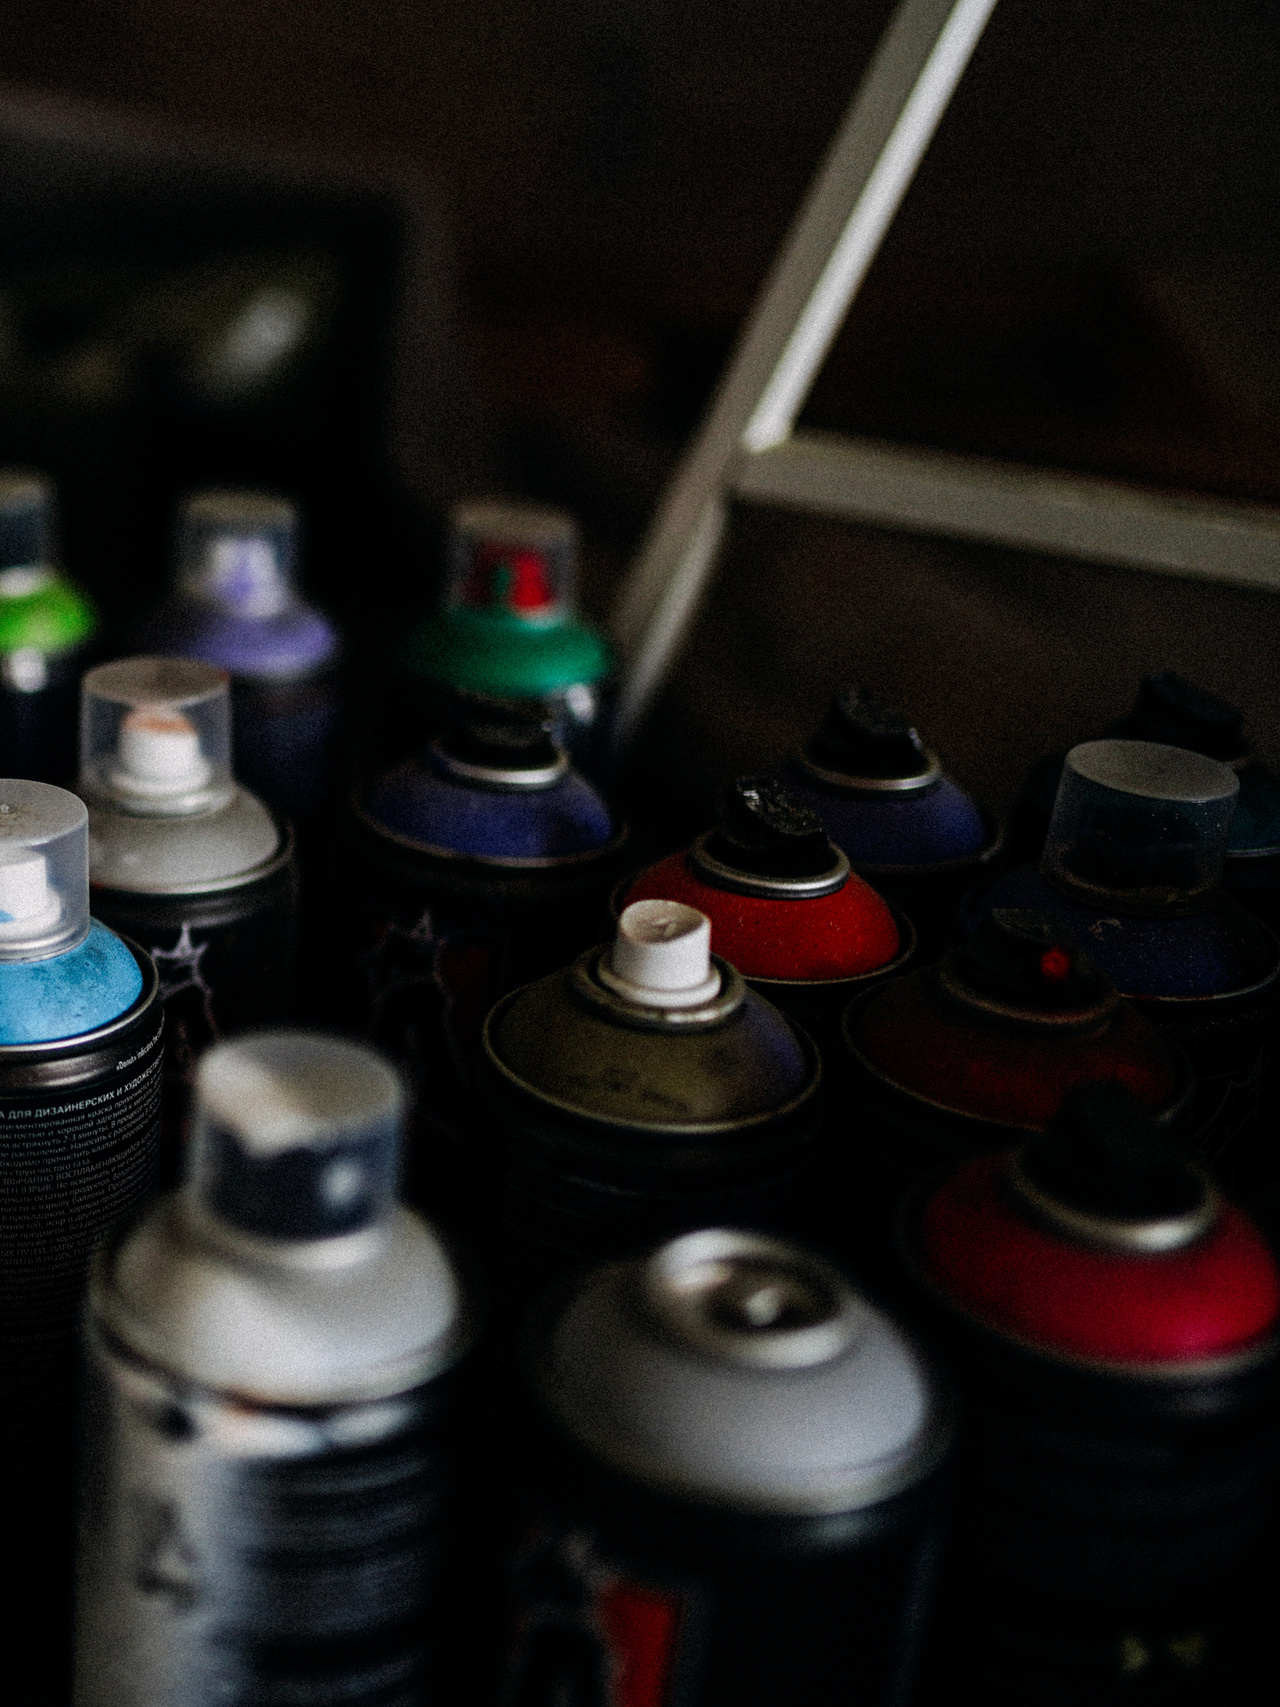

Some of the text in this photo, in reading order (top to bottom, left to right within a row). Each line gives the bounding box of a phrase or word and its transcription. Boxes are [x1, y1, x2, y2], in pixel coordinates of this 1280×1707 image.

[8, 1109, 32, 1120] ДЛЯ
[34, 1090, 115, 1119] ДИЗАЙНЕРСКИХ
[116, 1086, 122, 1096] И
[87, 1105, 113, 1119] краска
[56, 1120, 94, 1135] хорошей
[12, 1139, 61, 1150] встряхнуть
[63, 1134, 76, 1144] 2-3
[70, 1136, 107, 1150] Наносить
[42, 1150, 90, 1167] прочистить
[91, 1140, 118, 1154] клапан
[37, 1163, 71, 1174] чистого
[20, 1184, 54, 1194] ВЗРЫВ.
[56, 1181, 68, 1189] Не
[70, 1169, 110, 1187] вскрывать
[34, 1191, 68, 1202] остатки
[38, 1200, 70, 1211] взрыву
[71, 1189, 107, 1205] баллона.
[69, 1200, 100, 1214] хорошо
[8, 1335, 32, 1344] AND
